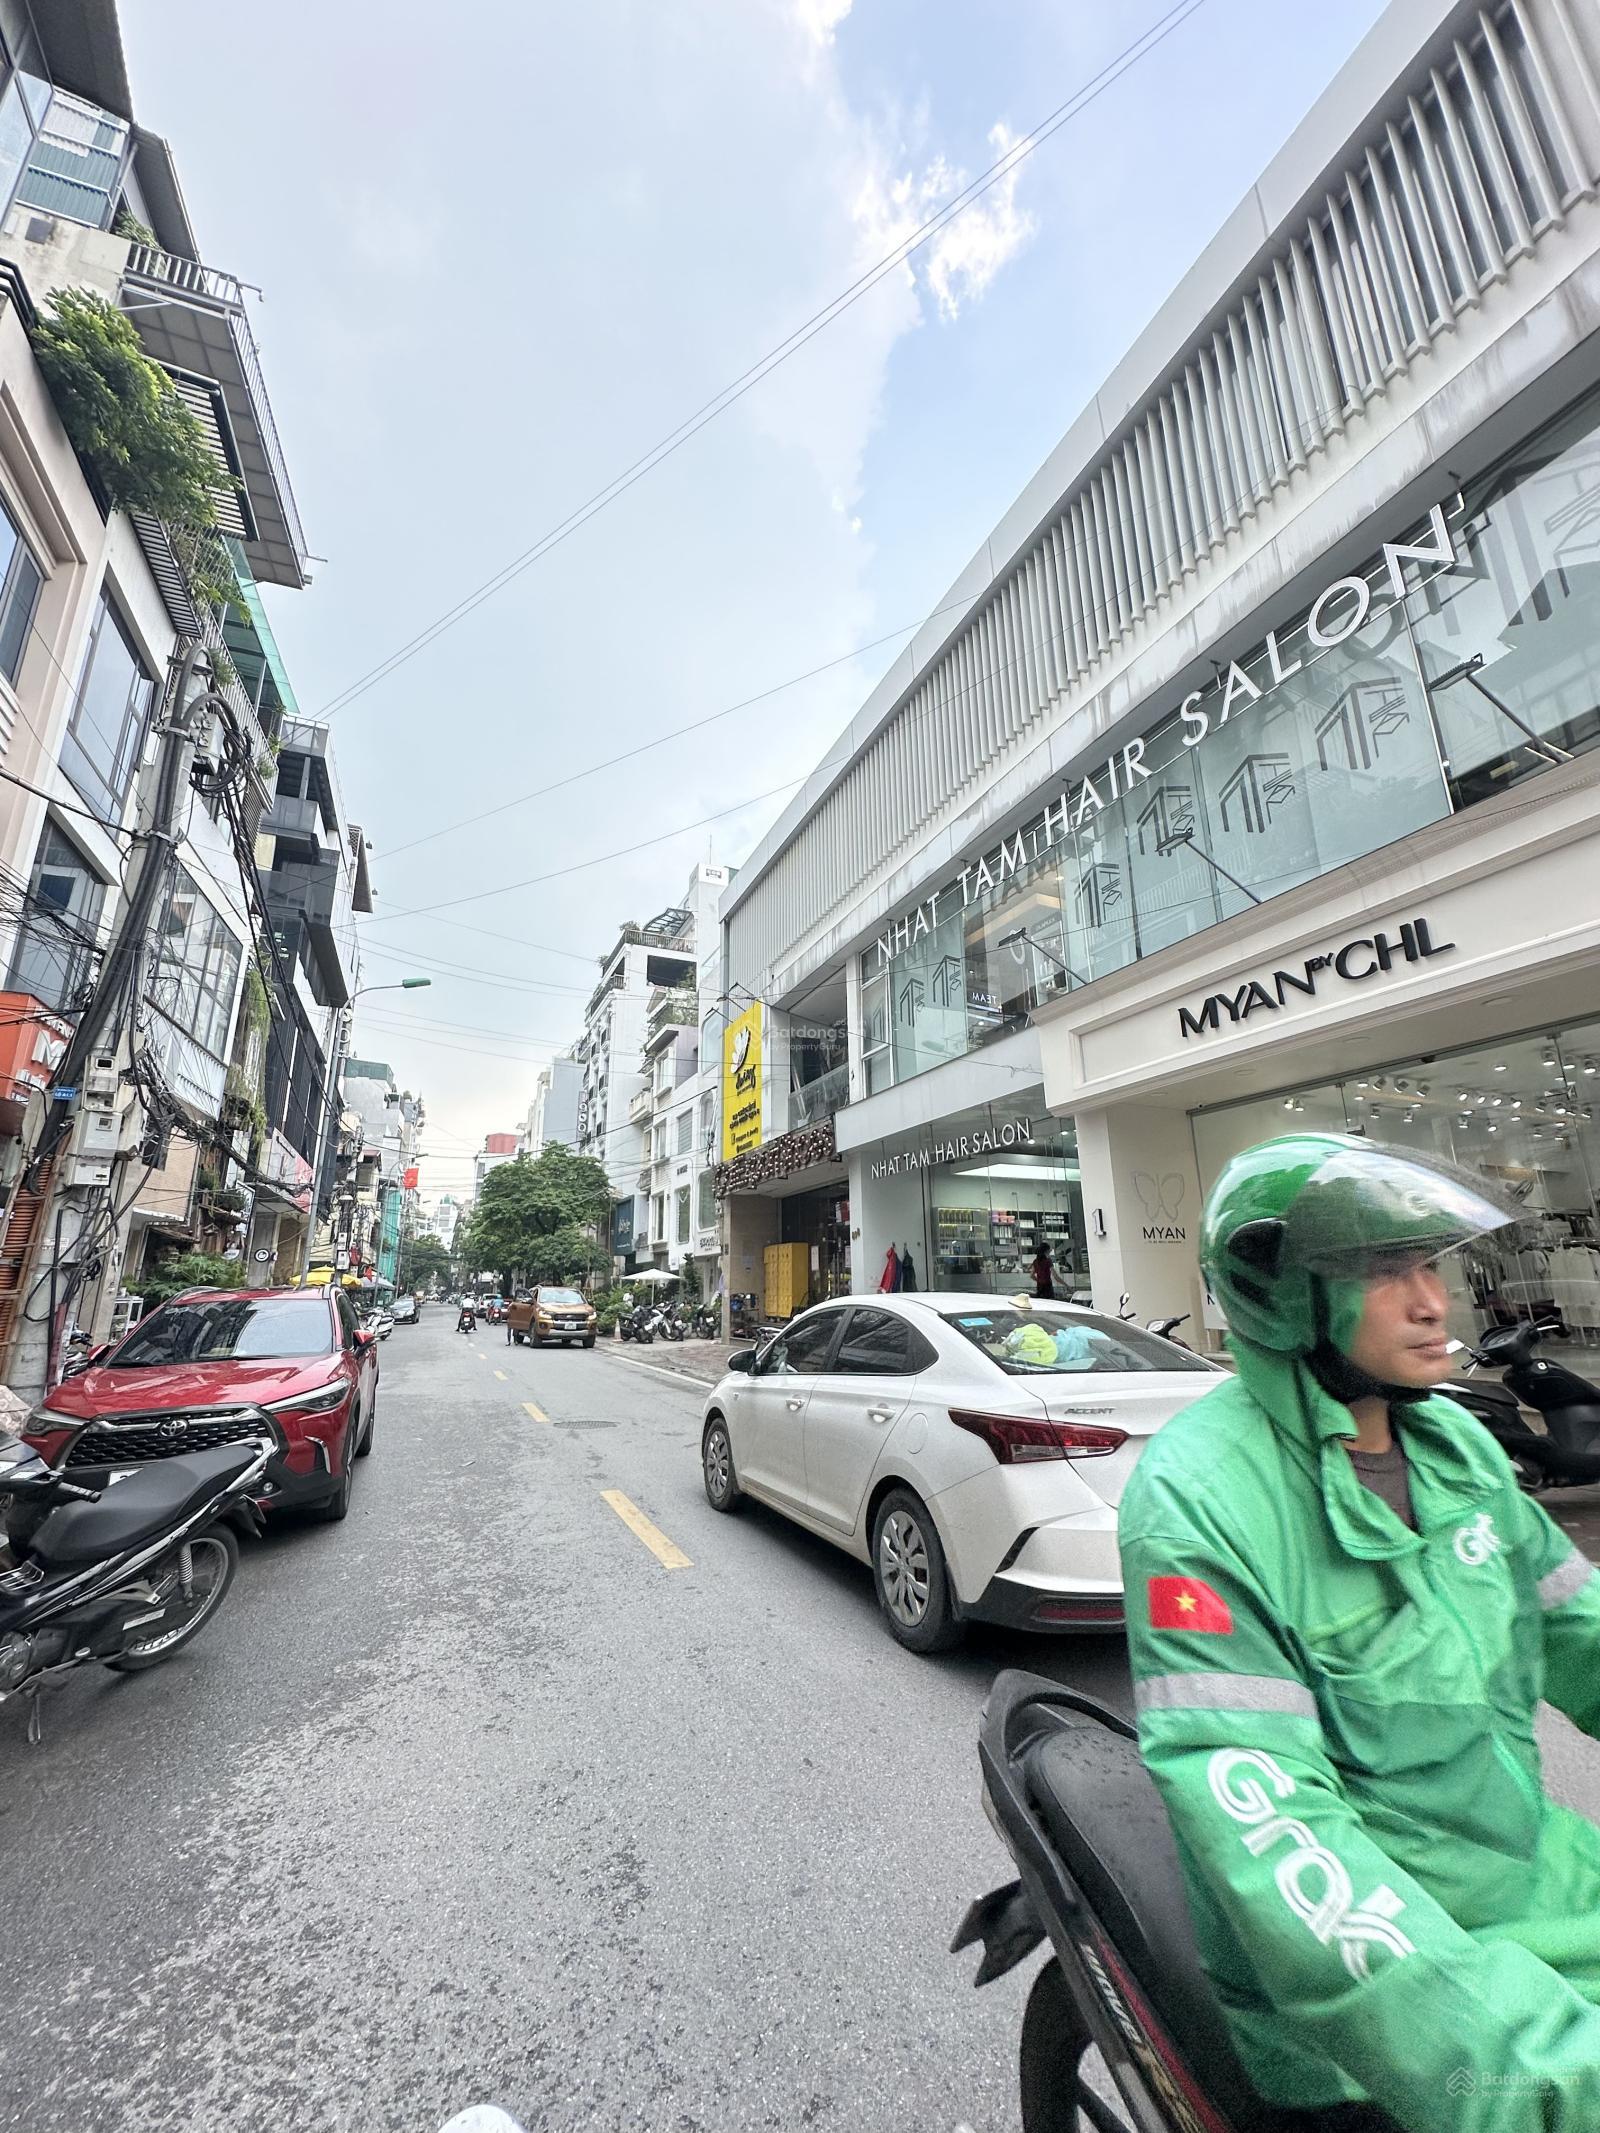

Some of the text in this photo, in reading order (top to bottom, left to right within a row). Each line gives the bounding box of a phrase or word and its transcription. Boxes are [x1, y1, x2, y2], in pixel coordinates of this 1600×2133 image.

[877, 503, 1456, 967] NHAT TAM HAIR SALON
[1178, 918, 1456, 1038] MYAN BY CHL
[871, 1118, 1031, 1179] NHAT TAM HAIR SALON
[1092, 1208, 1107, 1238] 1
[1143, 1227, 1186, 1240] MYAN
[1064, 1407, 1117, 1415] ACCENT
